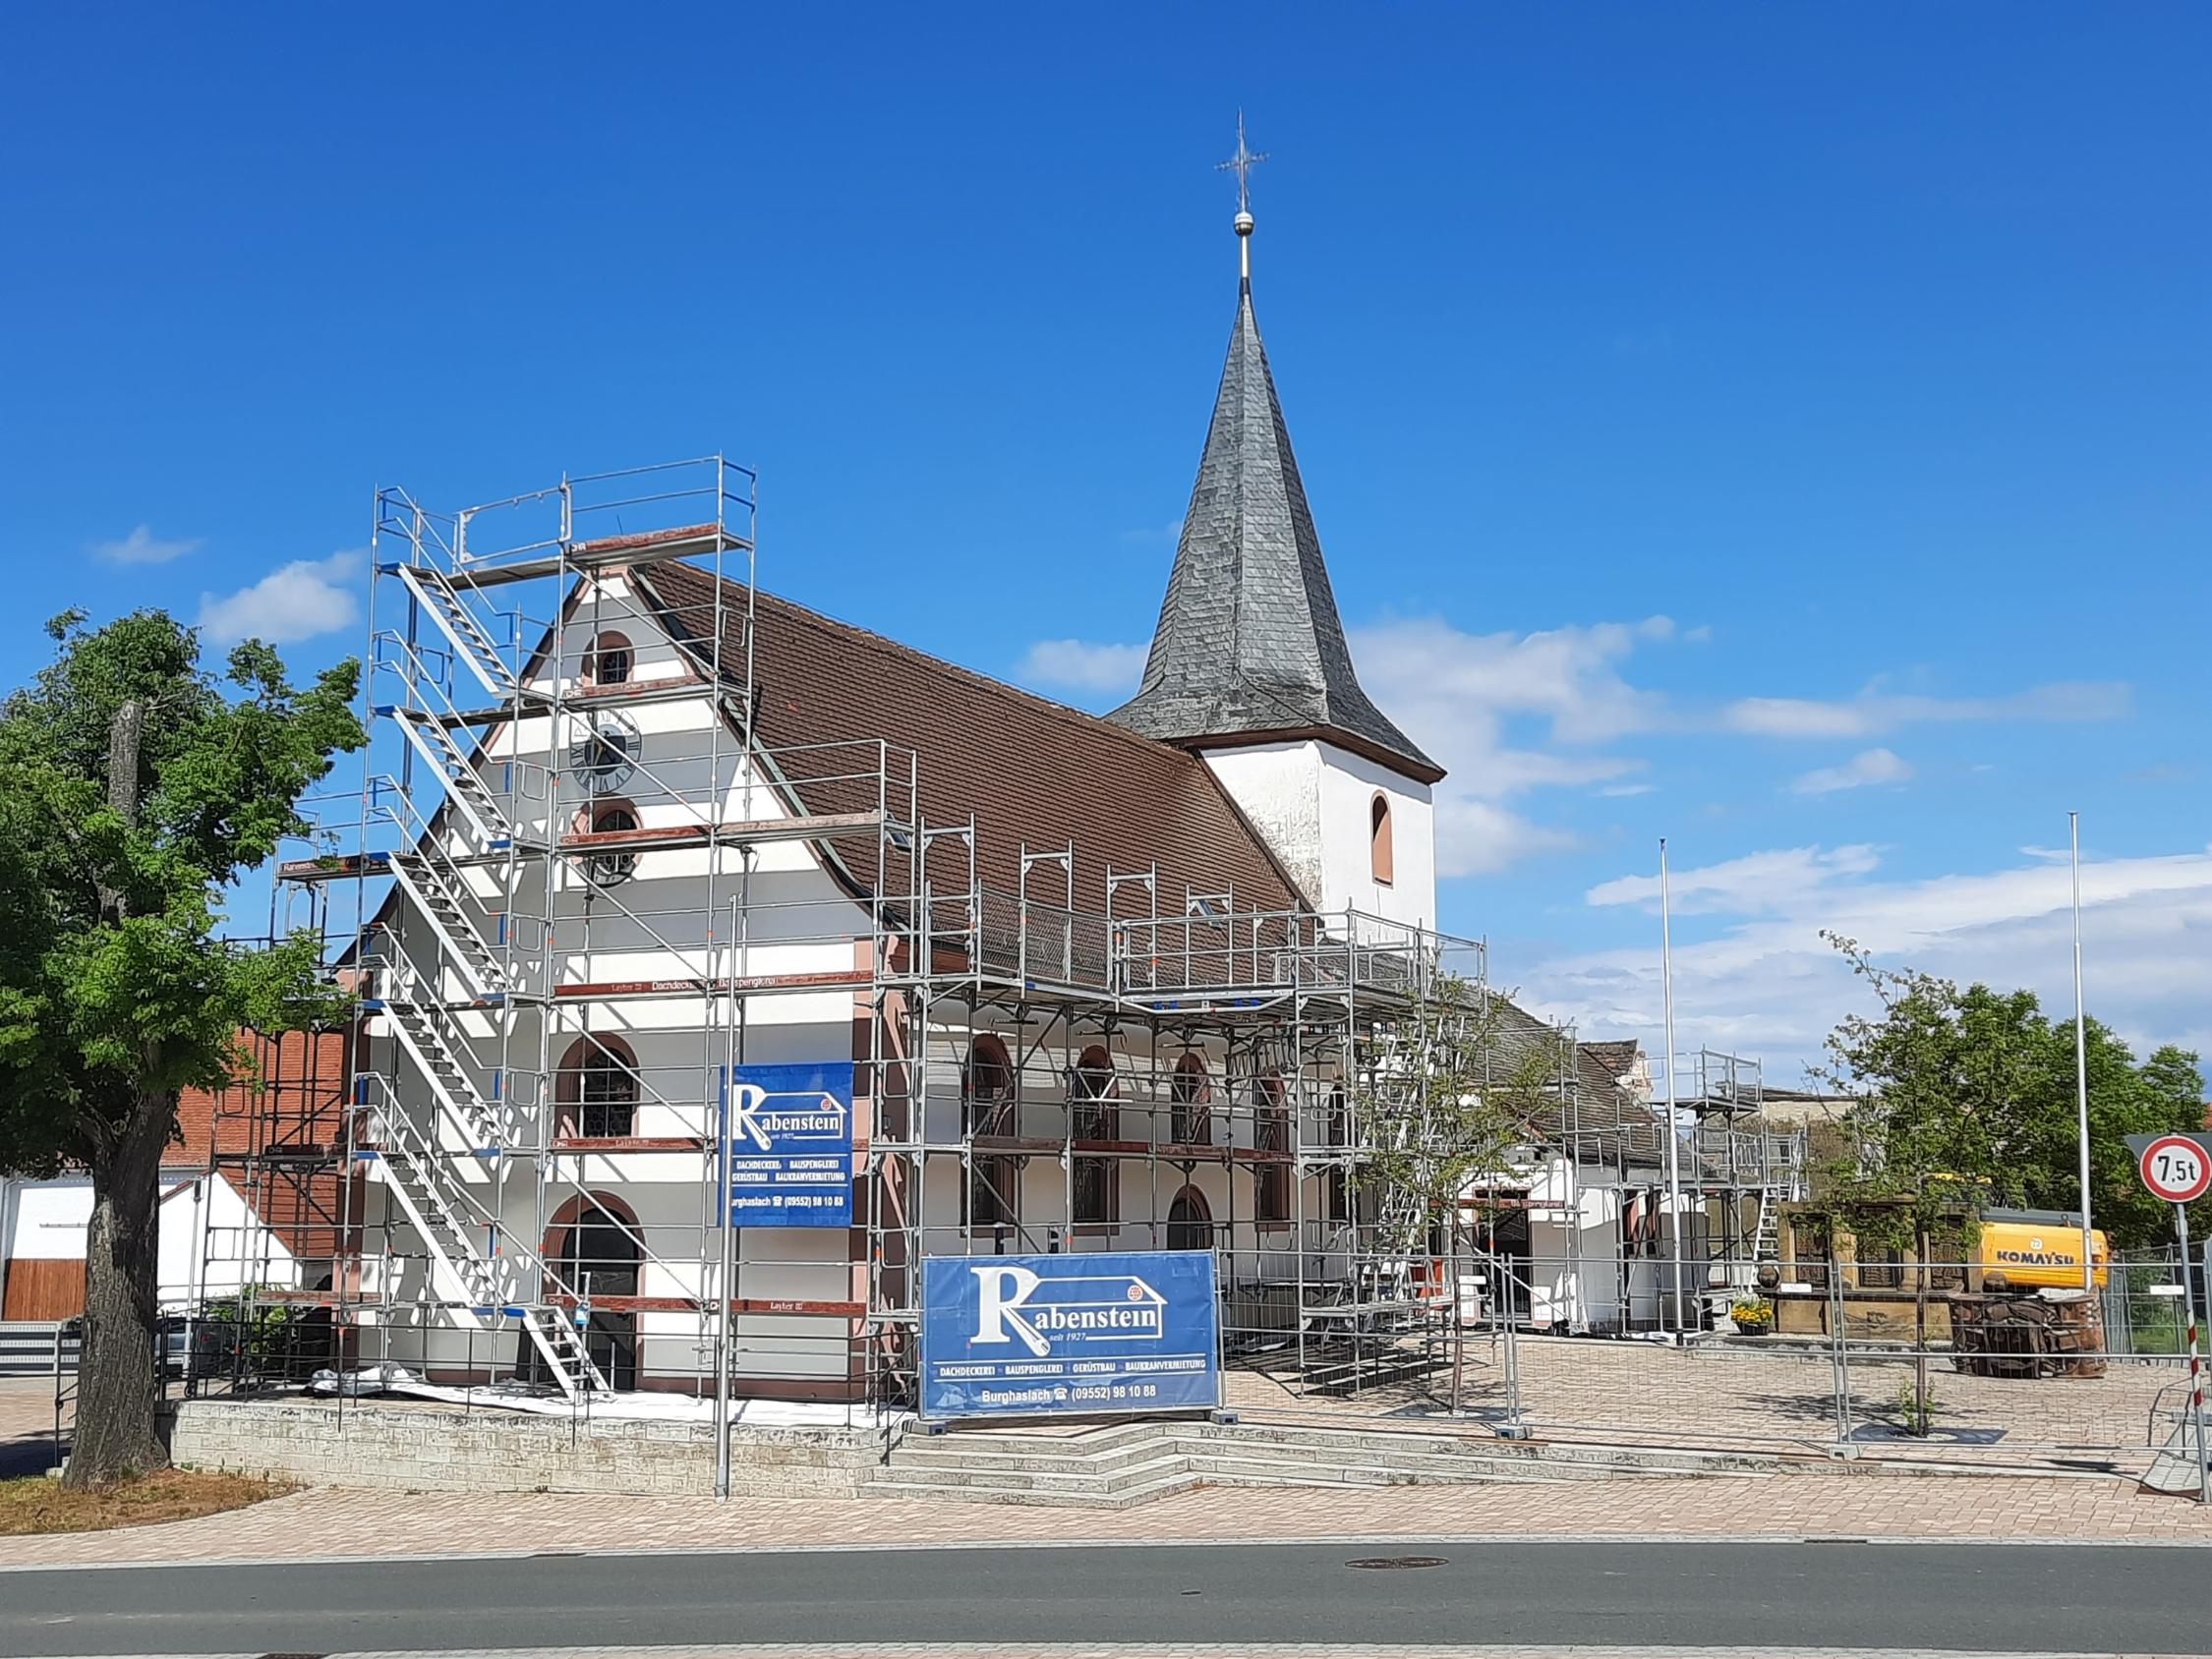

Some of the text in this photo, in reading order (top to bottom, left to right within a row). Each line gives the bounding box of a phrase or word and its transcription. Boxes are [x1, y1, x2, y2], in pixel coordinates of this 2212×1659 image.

[1997, 1250, 2074, 1265] KOMATSU
[970, 1266, 1157, 1356] Rabenstein
[1066, 1333, 1086, 1342] 1927
[940, 1359, 1205, 1376] DACHDECKEREI BAUSPENGLEREI GERÜSTBAU BAUKRANVERMIETUNG
[982, 1385, 1156, 1405] Burghaslach (09552) 98 10 88
